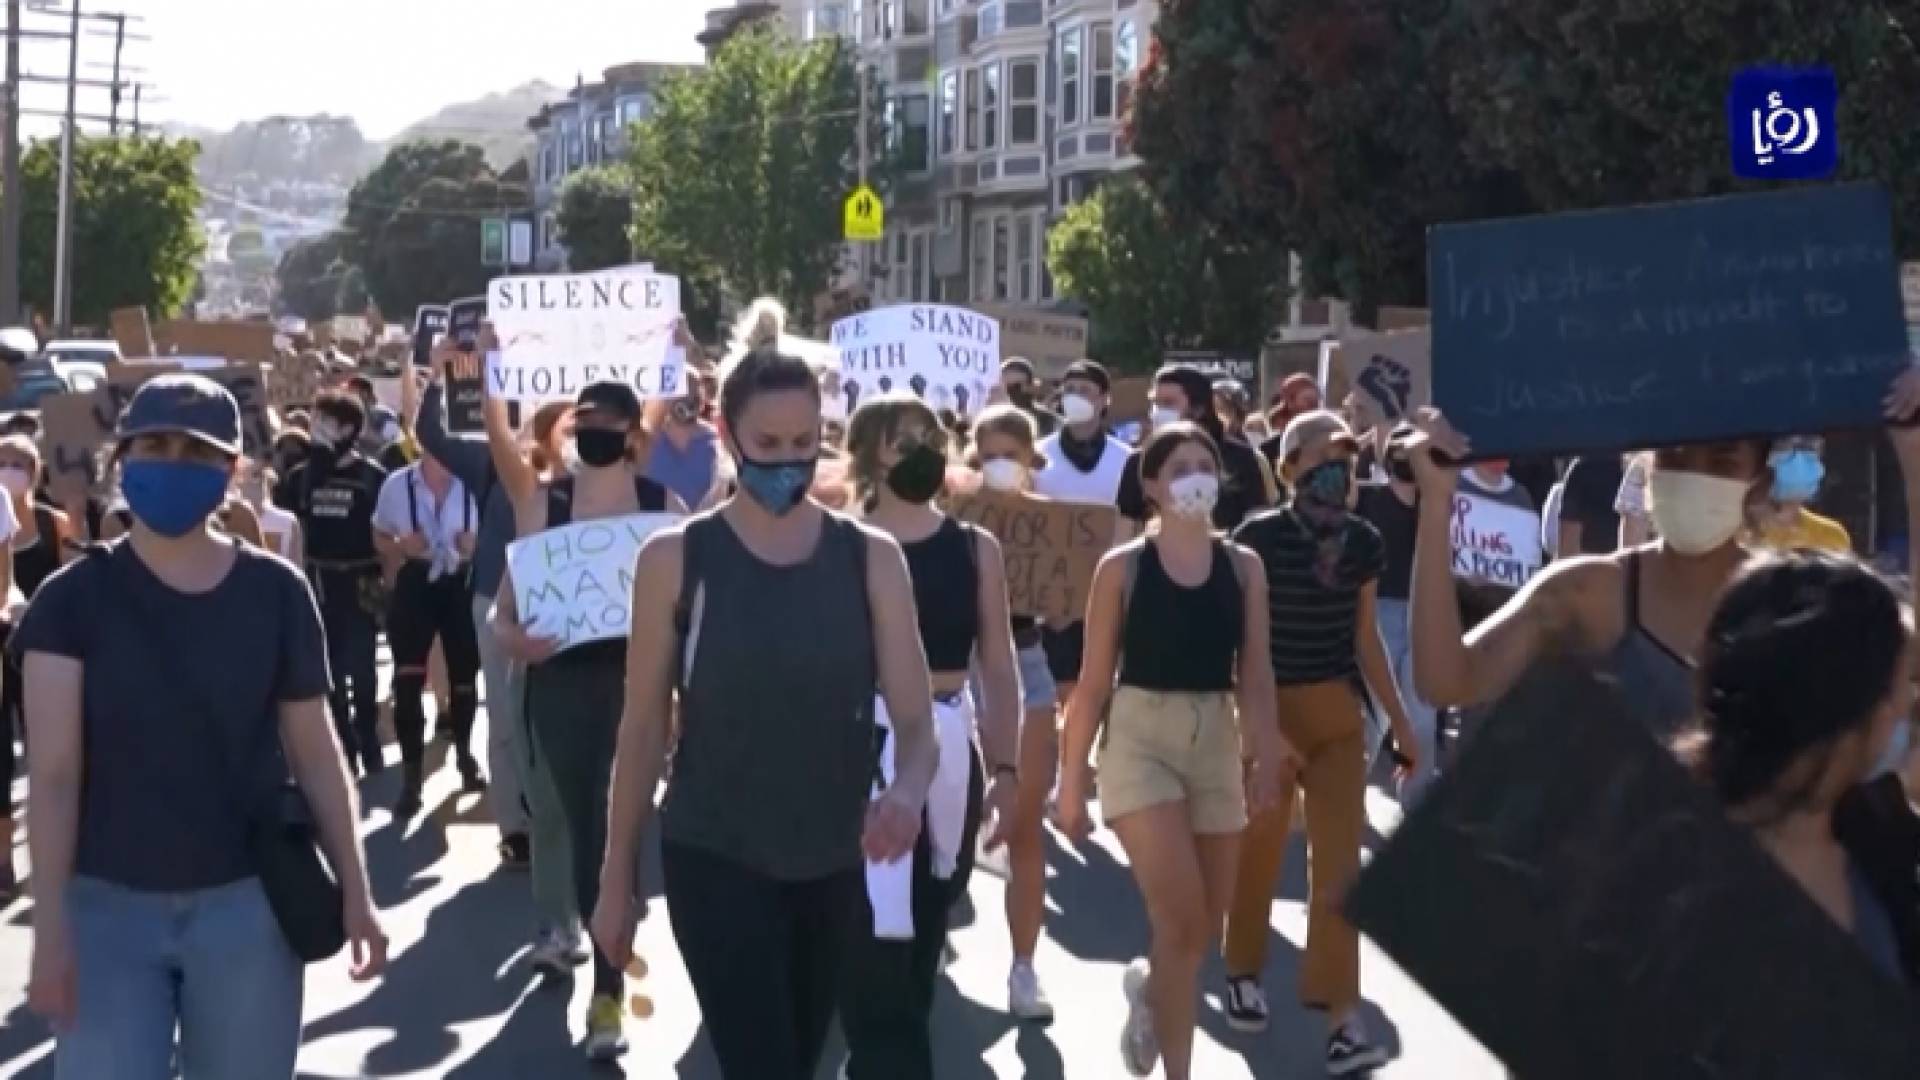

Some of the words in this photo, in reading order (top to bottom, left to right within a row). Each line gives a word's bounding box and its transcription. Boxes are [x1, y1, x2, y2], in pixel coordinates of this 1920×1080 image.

[498, 279, 663, 310] SILENCE
[836, 316, 869, 344] WE
[841, 342, 906, 371] WITH
[937, 342, 989, 374] YOU
[1065, 511, 1097, 549] IS
